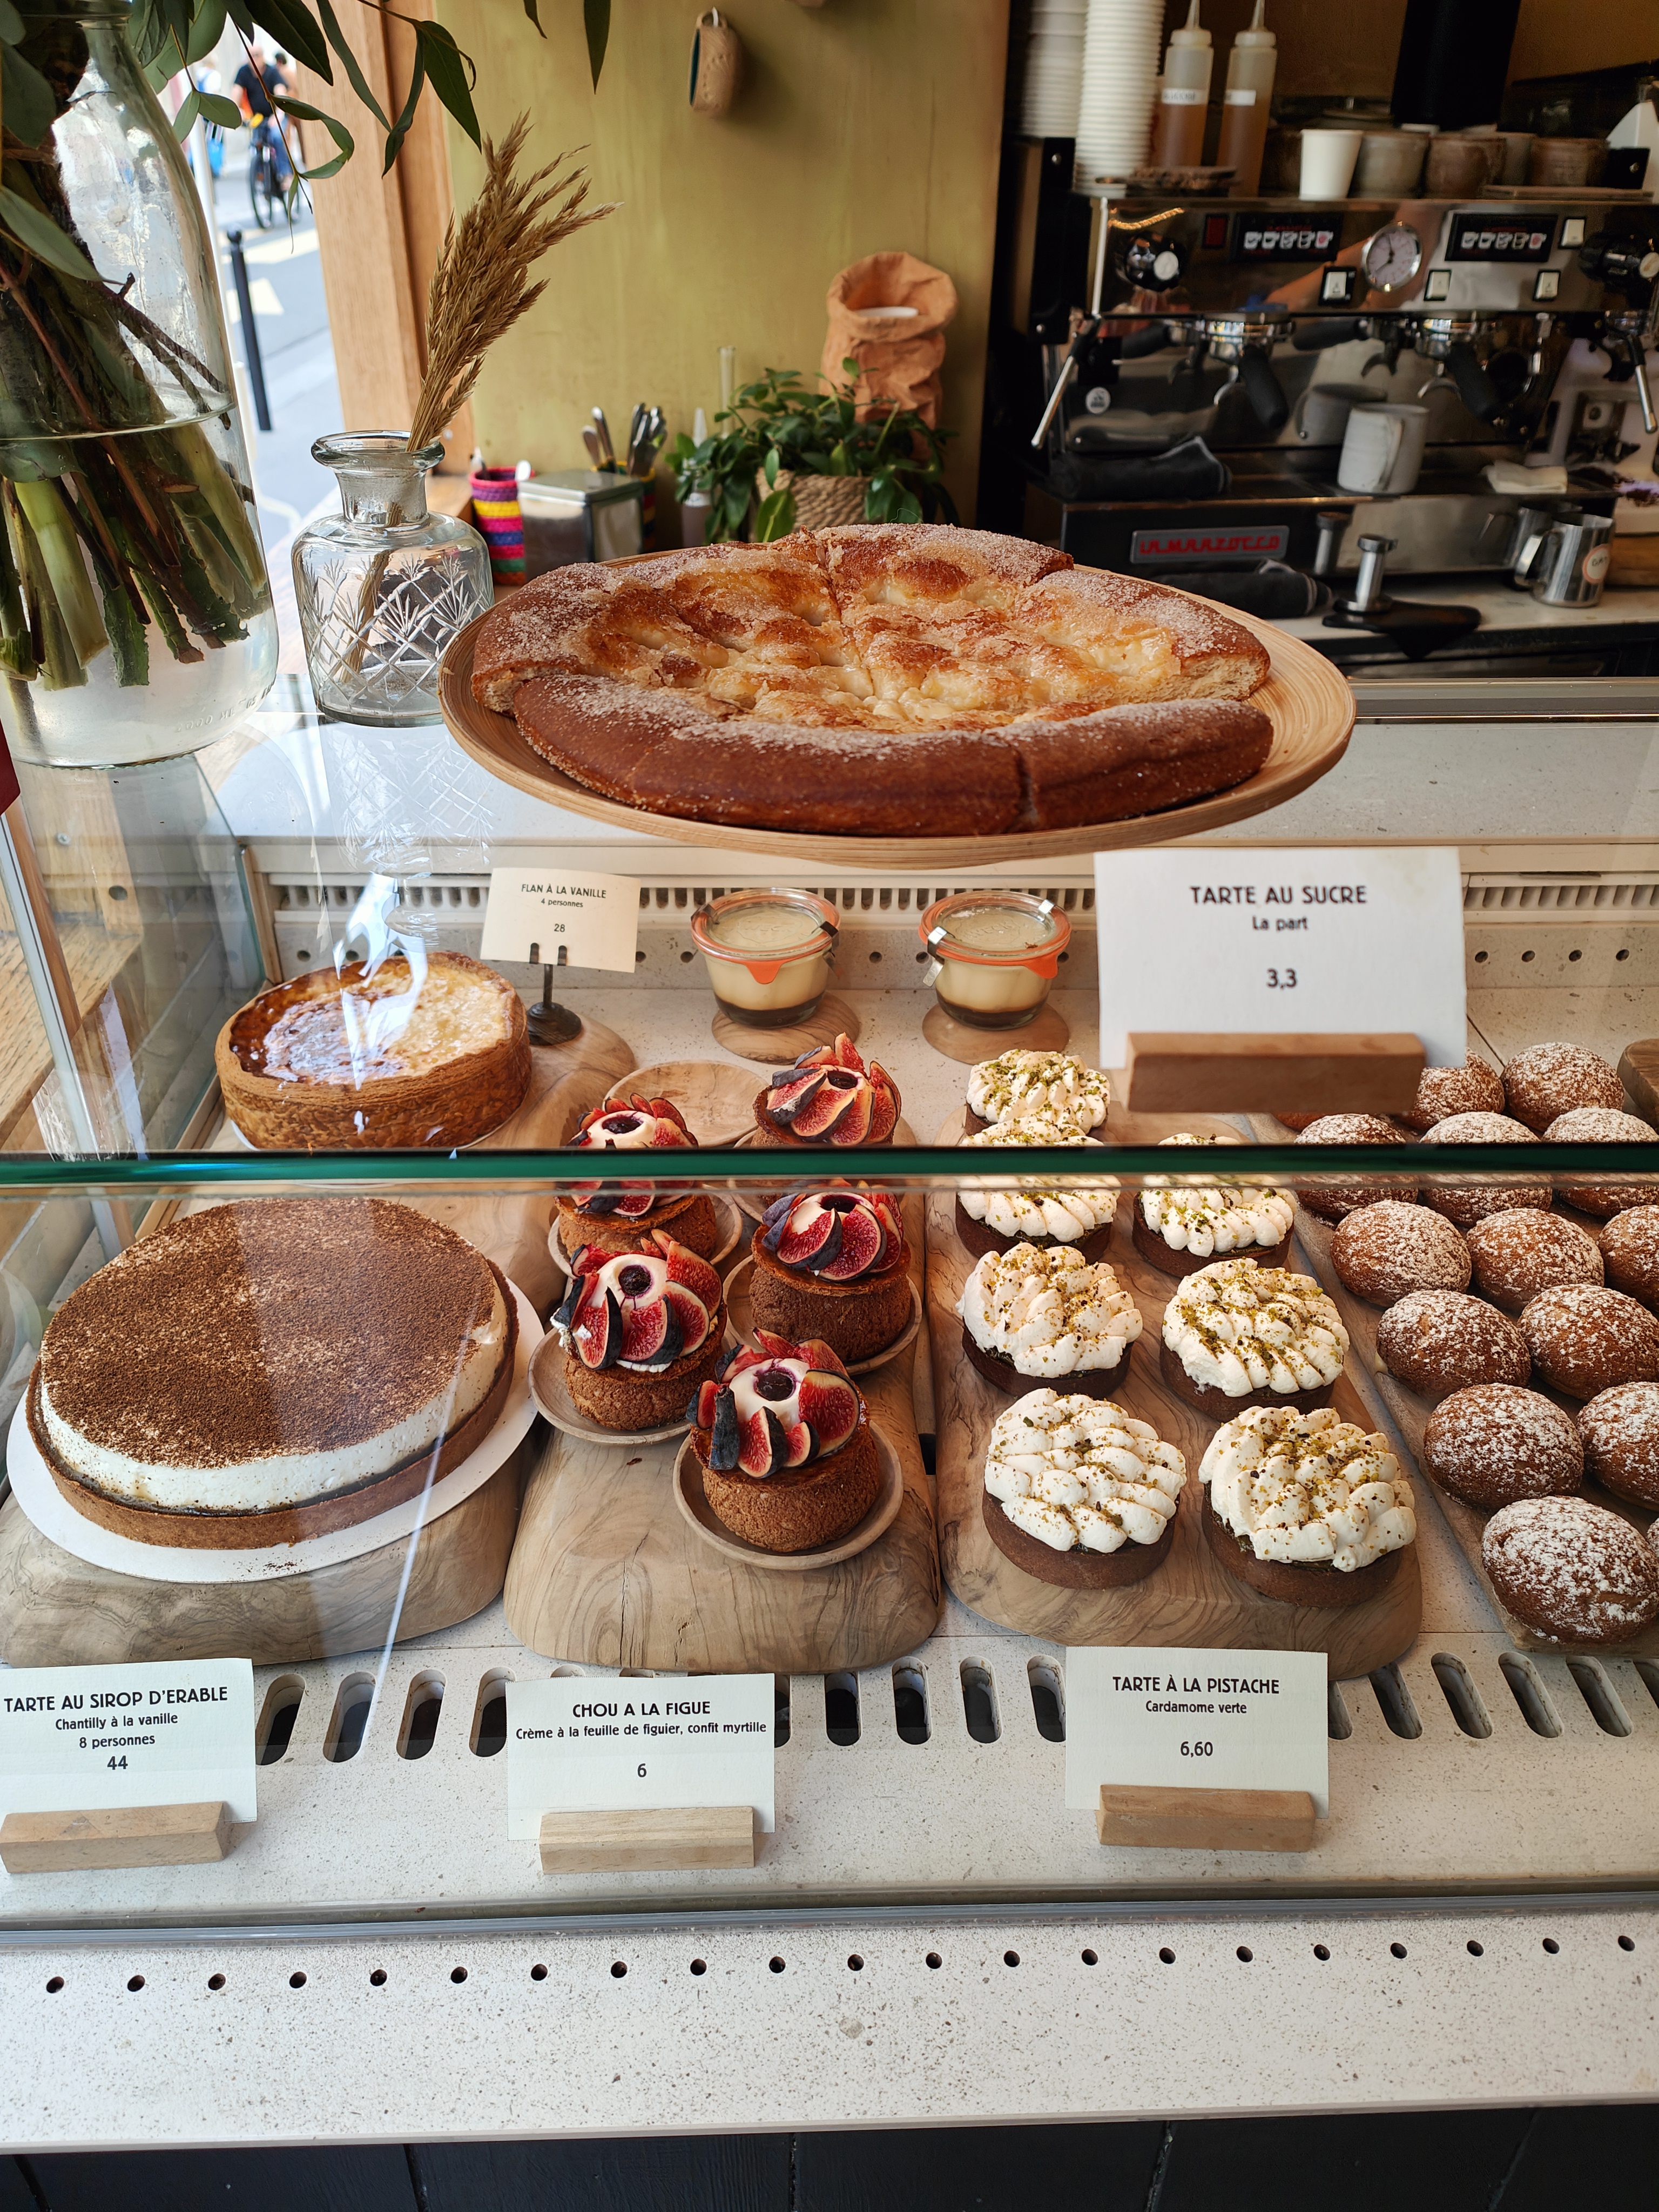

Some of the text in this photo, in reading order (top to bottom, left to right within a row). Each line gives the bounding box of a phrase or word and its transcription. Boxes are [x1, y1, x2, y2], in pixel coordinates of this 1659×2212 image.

[1165, 536, 1280, 554] MARZOCCO
[521, 884, 606, 899] FLAN À LA VANILLE
[1190, 885, 1366, 904] TARTE AU SUCRE
[548, 899, 584, 908] personnes
[554, 923, 565, 933] 28
[1252, 916, 1308, 932] La part
[1267, 968, 1297, 989] 3,3
[1112, 1674, 1279, 1694] TARTE À LA PISTACHE
[3, 1686, 228, 1712] TARTE AU SIROP D'ERABLE
[1145, 1700, 1247, 1714] Cardamome verte
[572, 1701, 711, 1718] CHOU A LA FIGUE
[55, 1712, 178, 1730] Chantilly à la vanille
[516, 1722, 766, 1739] Crème à la feuille de figuier, confit myrtille
[79, 1735, 156, 1750] 8 personnes
[1180, 1741, 1213, 1758] 6,60
[107, 1755, 129, 1770] 44
[637, 1763, 647, 1778] 6
